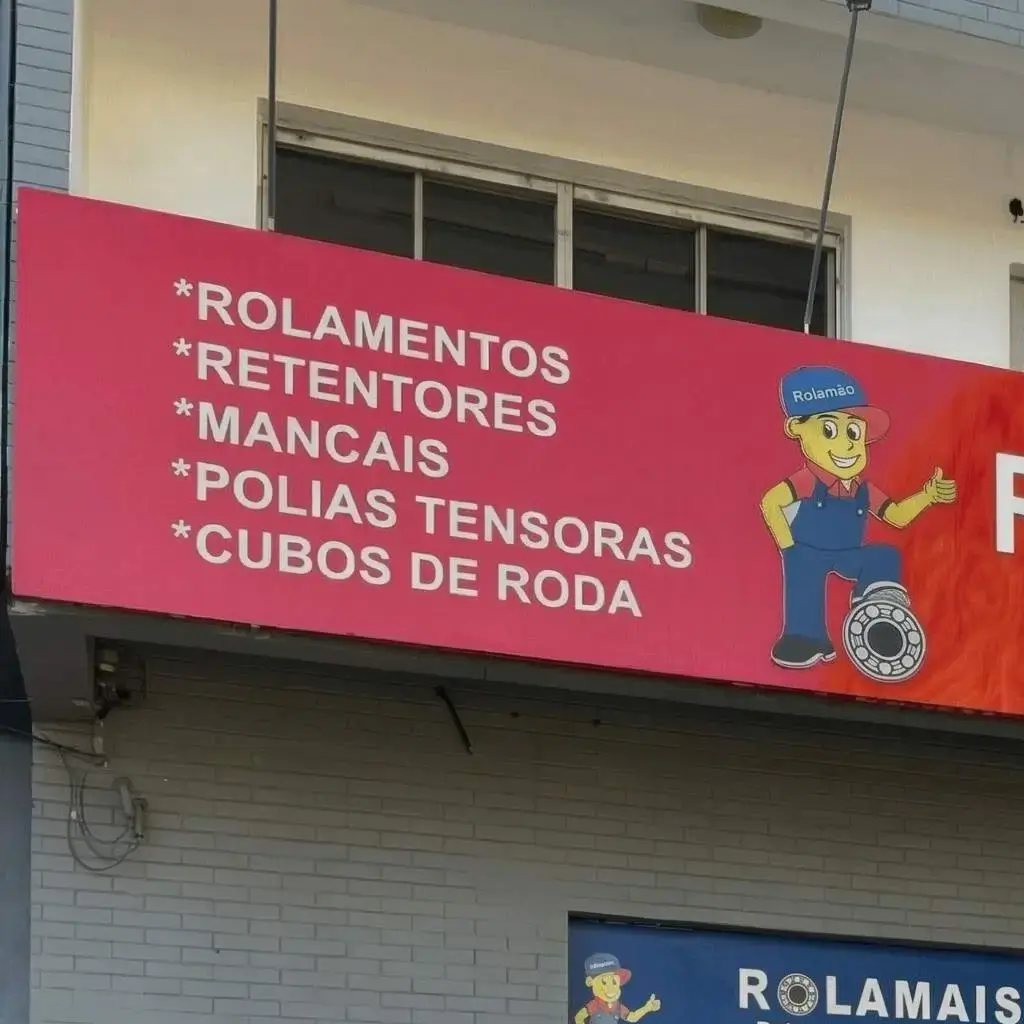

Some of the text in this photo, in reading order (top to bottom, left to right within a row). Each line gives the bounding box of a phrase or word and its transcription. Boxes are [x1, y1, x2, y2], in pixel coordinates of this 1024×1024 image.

[792, 384, 855, 403] Rolamão
[416, 494, 693, 569] TENSORAS
[411, 552, 479, 598] DE
[497, 562, 643, 617] RODA
